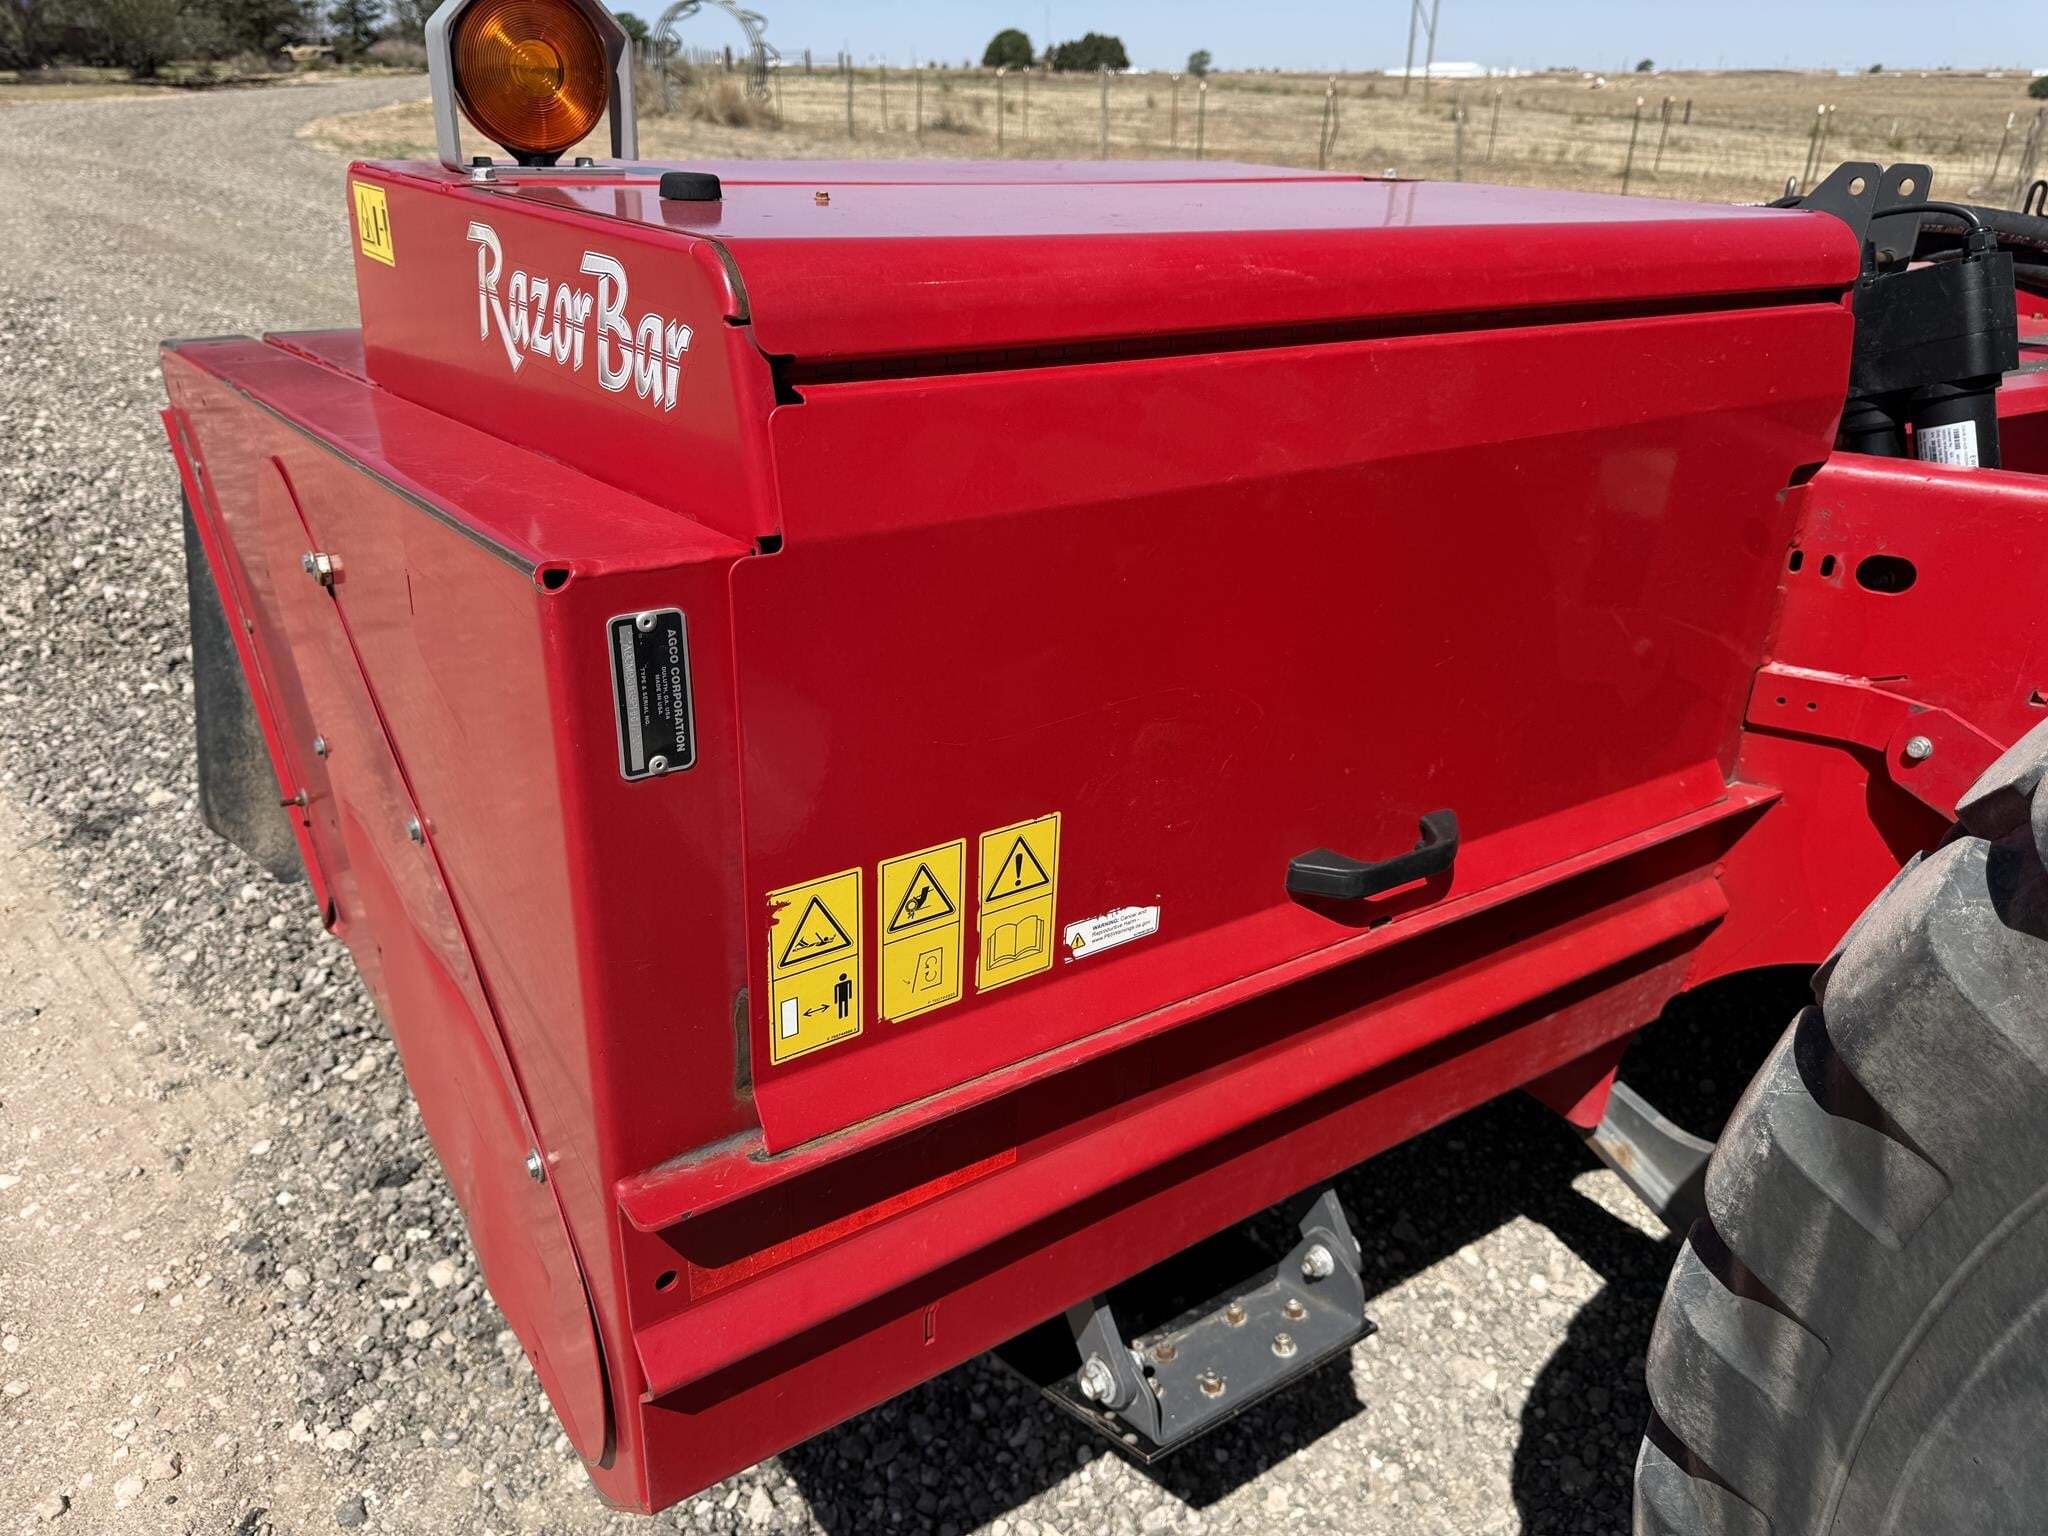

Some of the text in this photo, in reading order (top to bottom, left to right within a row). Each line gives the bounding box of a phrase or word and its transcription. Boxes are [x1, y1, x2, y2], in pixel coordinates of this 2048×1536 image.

[640, 667, 648, 684] TYPE
[655, 674, 663, 692] MADE
[667, 629, 686, 753] AGCO CORPORATION
[642, 692, 650, 714] SERIAL
[657, 702, 666, 715] USA
